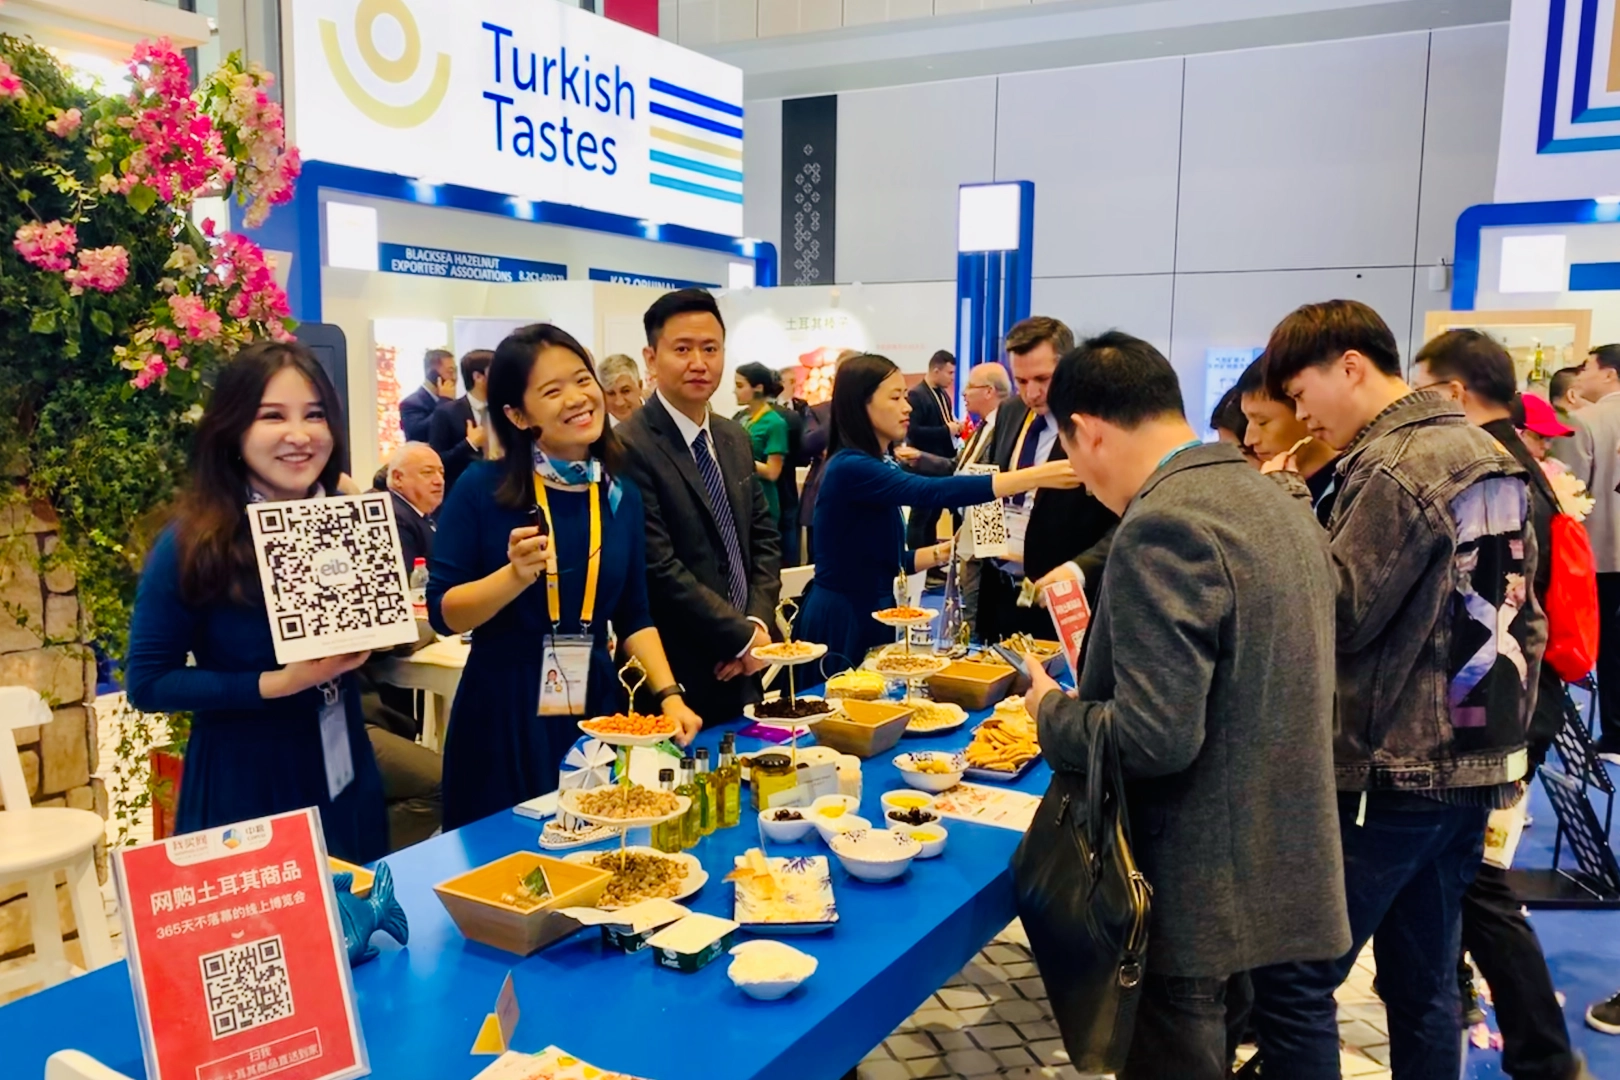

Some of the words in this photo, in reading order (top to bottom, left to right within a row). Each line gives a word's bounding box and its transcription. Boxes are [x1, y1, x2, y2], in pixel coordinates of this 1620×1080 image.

[482, 21, 635, 120] Turkish
[483, 91, 617, 175] Tastes
[391, 259, 448, 276] EXPORTERS'
[450, 265, 513, 282] ASSOCIATIONS
[405, 247, 452, 264] BLACKSEA
[454, 253, 500, 269] HAZELNUT
[320, 559, 350, 576] eib
[150, 859, 303, 916] 网购土耳其商品
[156, 890, 306, 939] 365天不落幕的线上博览会
